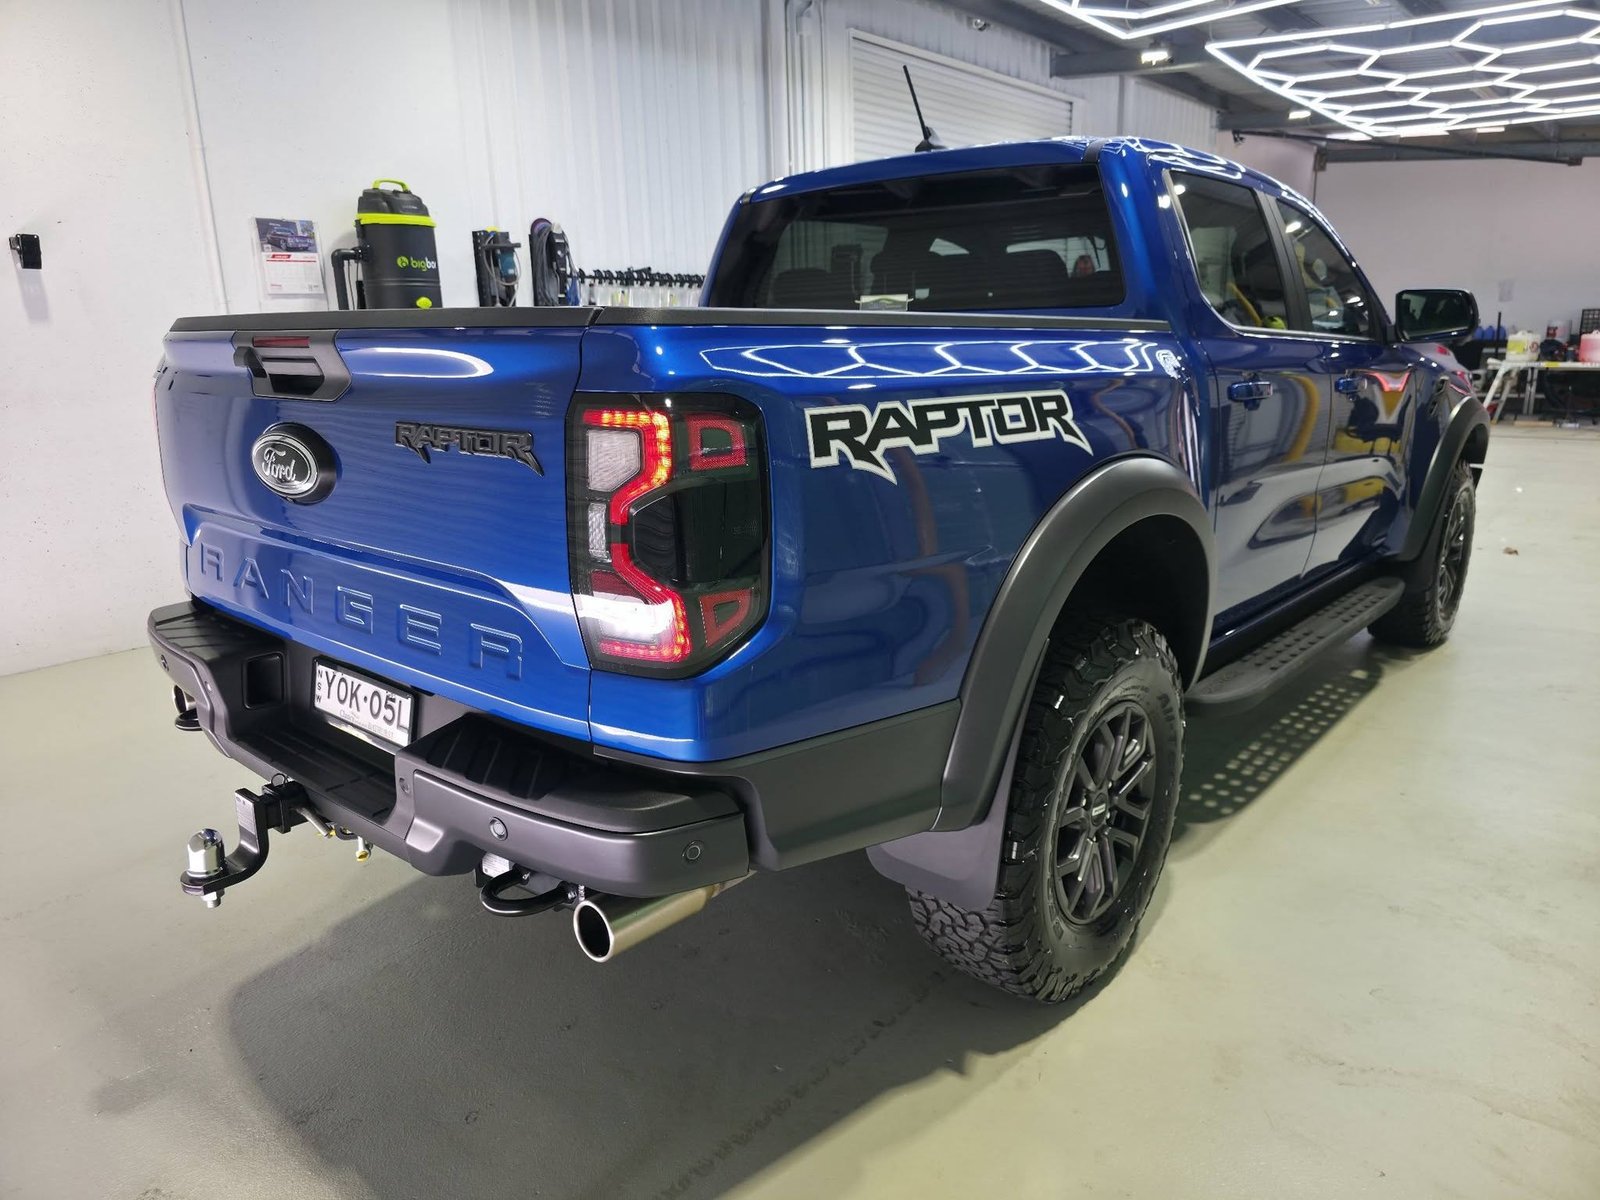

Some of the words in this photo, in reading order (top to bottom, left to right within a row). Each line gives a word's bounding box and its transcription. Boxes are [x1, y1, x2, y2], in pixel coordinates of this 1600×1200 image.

[262, 447, 296, 481] Ford
[396, 421, 545, 477] RAPTOR
[804, 390, 1094, 485] RAPTOR
[201, 543, 523, 680] RANGER
